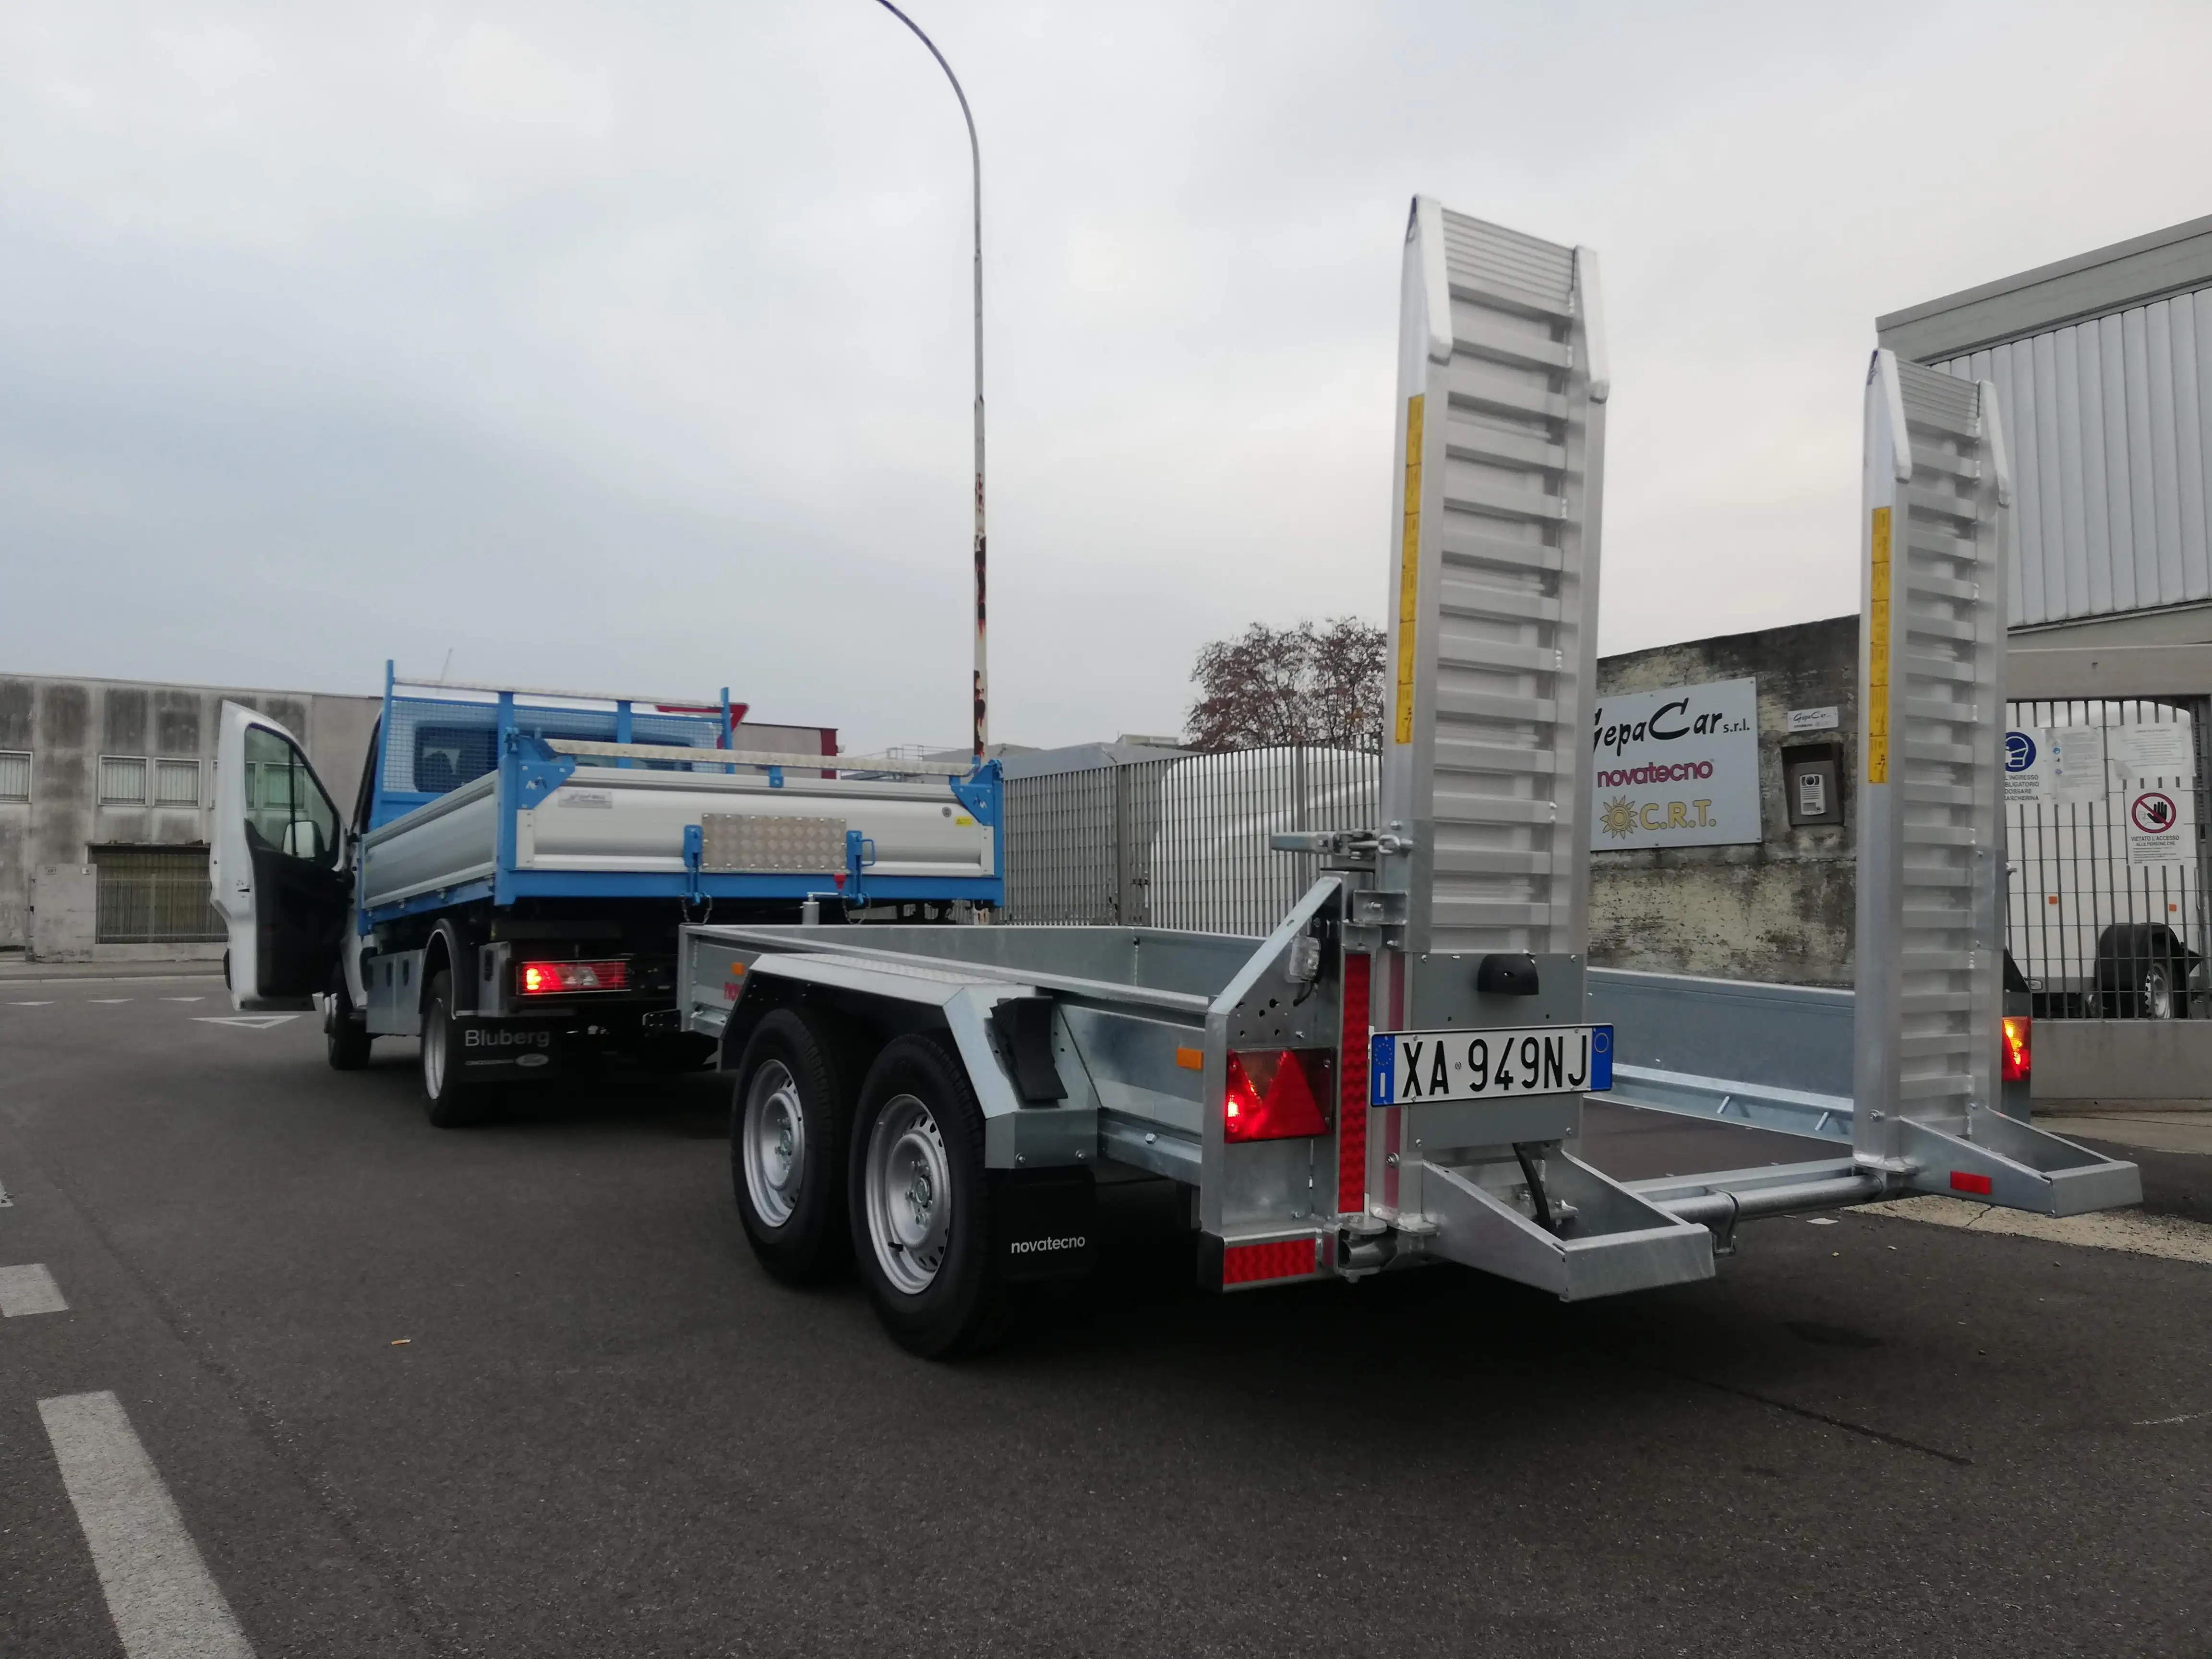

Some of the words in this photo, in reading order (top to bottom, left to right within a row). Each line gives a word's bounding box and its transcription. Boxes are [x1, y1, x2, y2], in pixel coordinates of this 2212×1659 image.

[1723, 718, 1750, 733] s.r.l.
[1597, 760, 1713, 788] novatecno
[1640, 799, 1717, 830] C.R.T.
[465, 1030, 550, 1047] Bluberg
[1403, 1041, 1449, 1097] XA
[1468, 1035, 1587, 1092] 949NJ
[1011, 1237, 1085, 1254] novatecno
